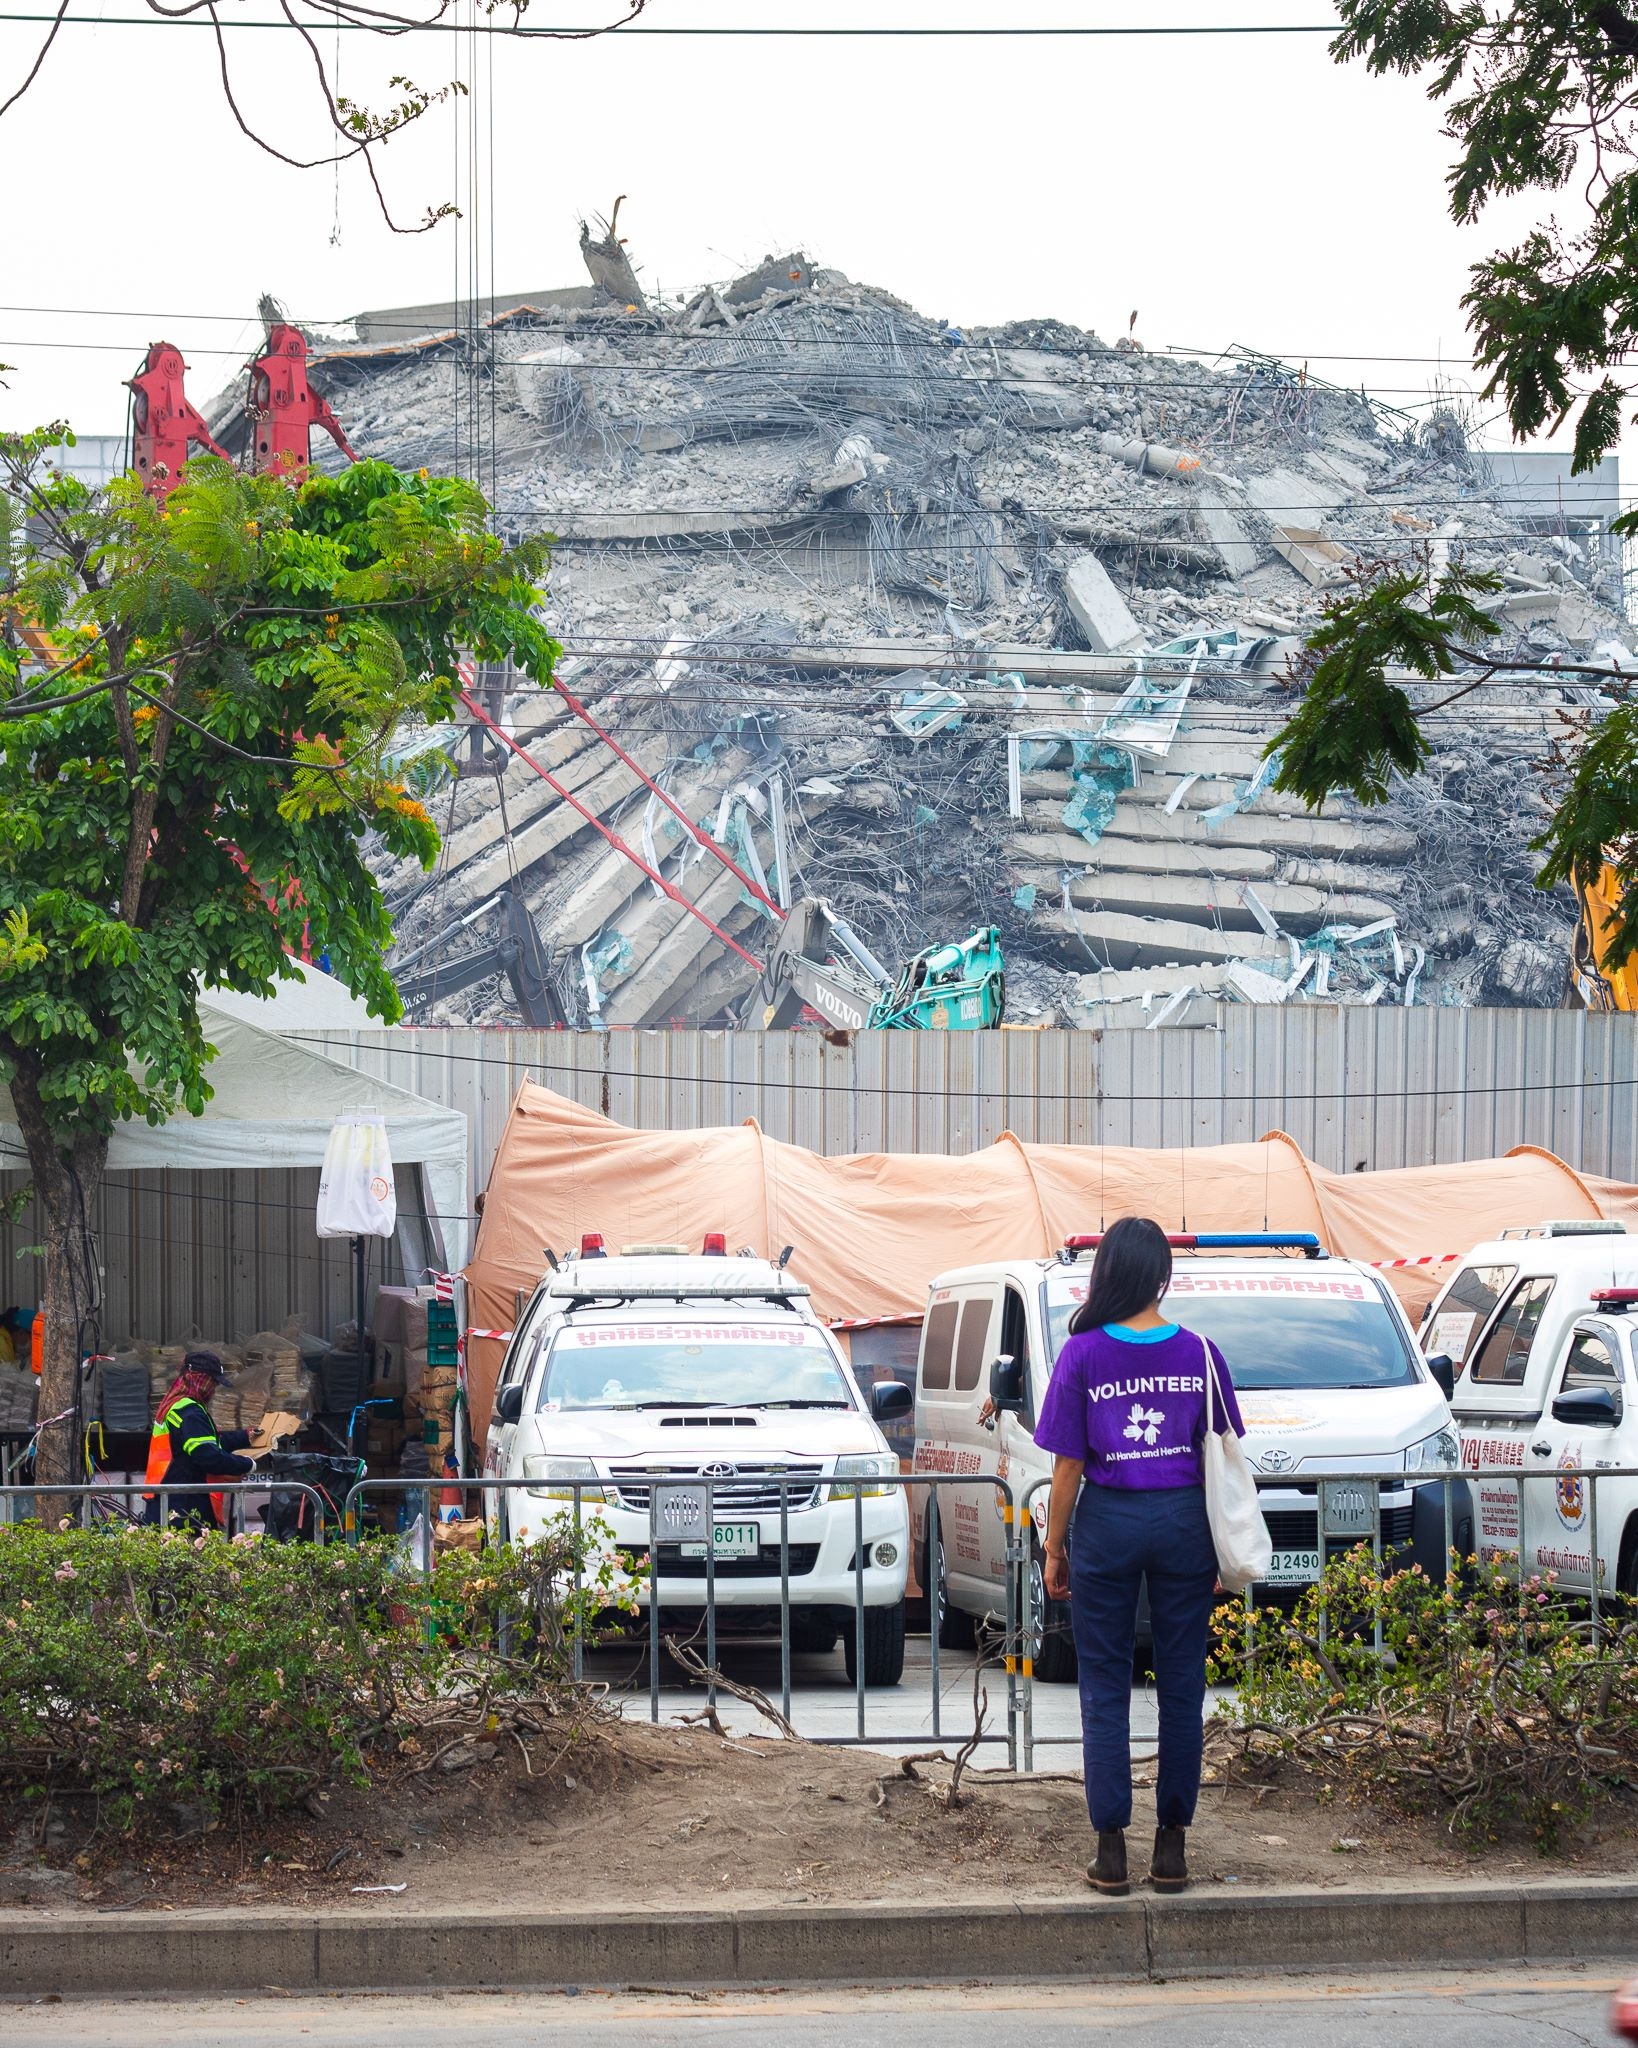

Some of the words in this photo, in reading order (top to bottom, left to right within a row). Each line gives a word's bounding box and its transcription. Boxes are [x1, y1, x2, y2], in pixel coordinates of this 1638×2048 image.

[816, 984, 862, 1029] VOLVO
[1069, 1276, 1364, 1302] มูร่วมกตัญญู
[576, 1326, 805, 1346] มูลนิธิร่วมกตัญญู
[1088, 1376, 1204, 1403] VOLUNTEER
[1116, 1450, 1141, 1461] Hands
[1142, 1448, 1160, 1458] and
[1160, 1445, 1191, 1457] Hearts
[714, 1527, 753, 1543] 6011
[692, 1548, 746, 1557] กรุงเพมหานคร
[1284, 1554, 1319, 1569] 2490
